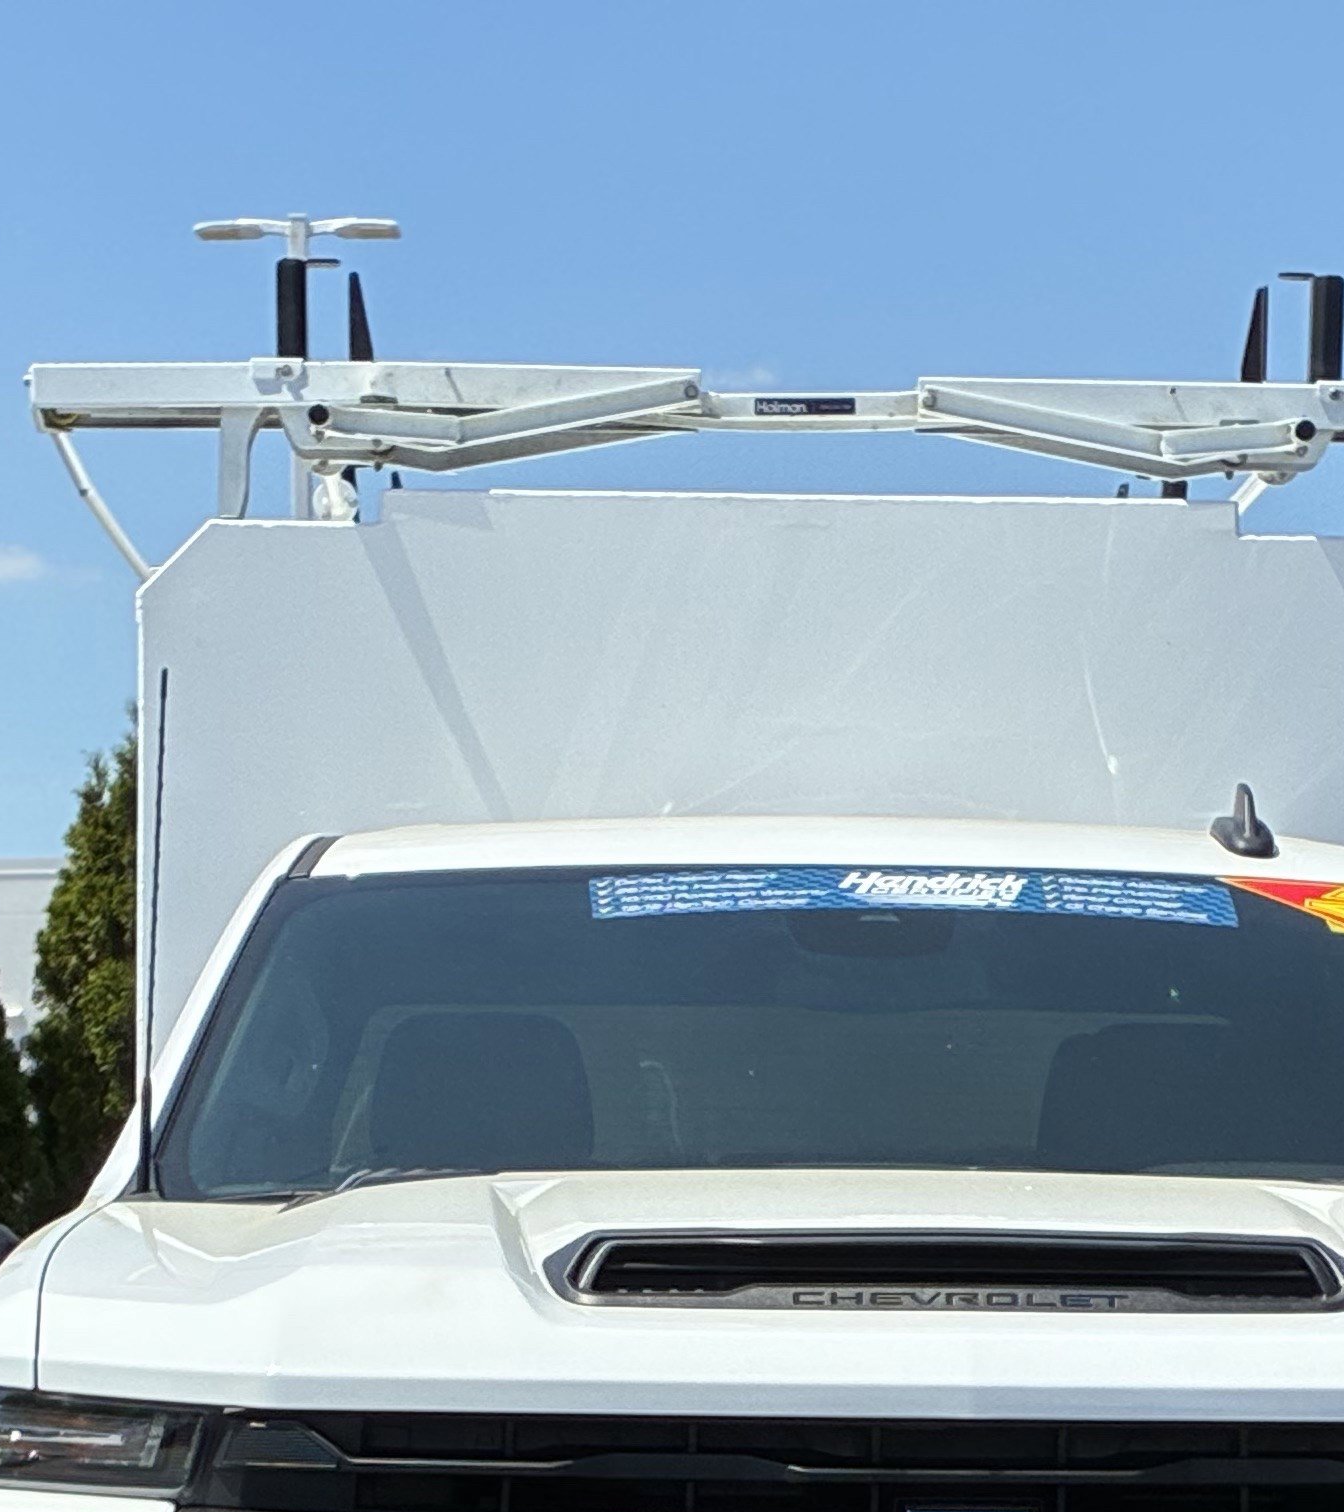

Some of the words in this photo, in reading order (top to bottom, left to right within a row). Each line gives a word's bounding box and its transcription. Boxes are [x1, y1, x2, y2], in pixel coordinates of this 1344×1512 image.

[756, 400, 808, 413] Holman
[838, 871, 1029, 895] Hendrick
[792, 1291, 1130, 1308] CHEVROLET
